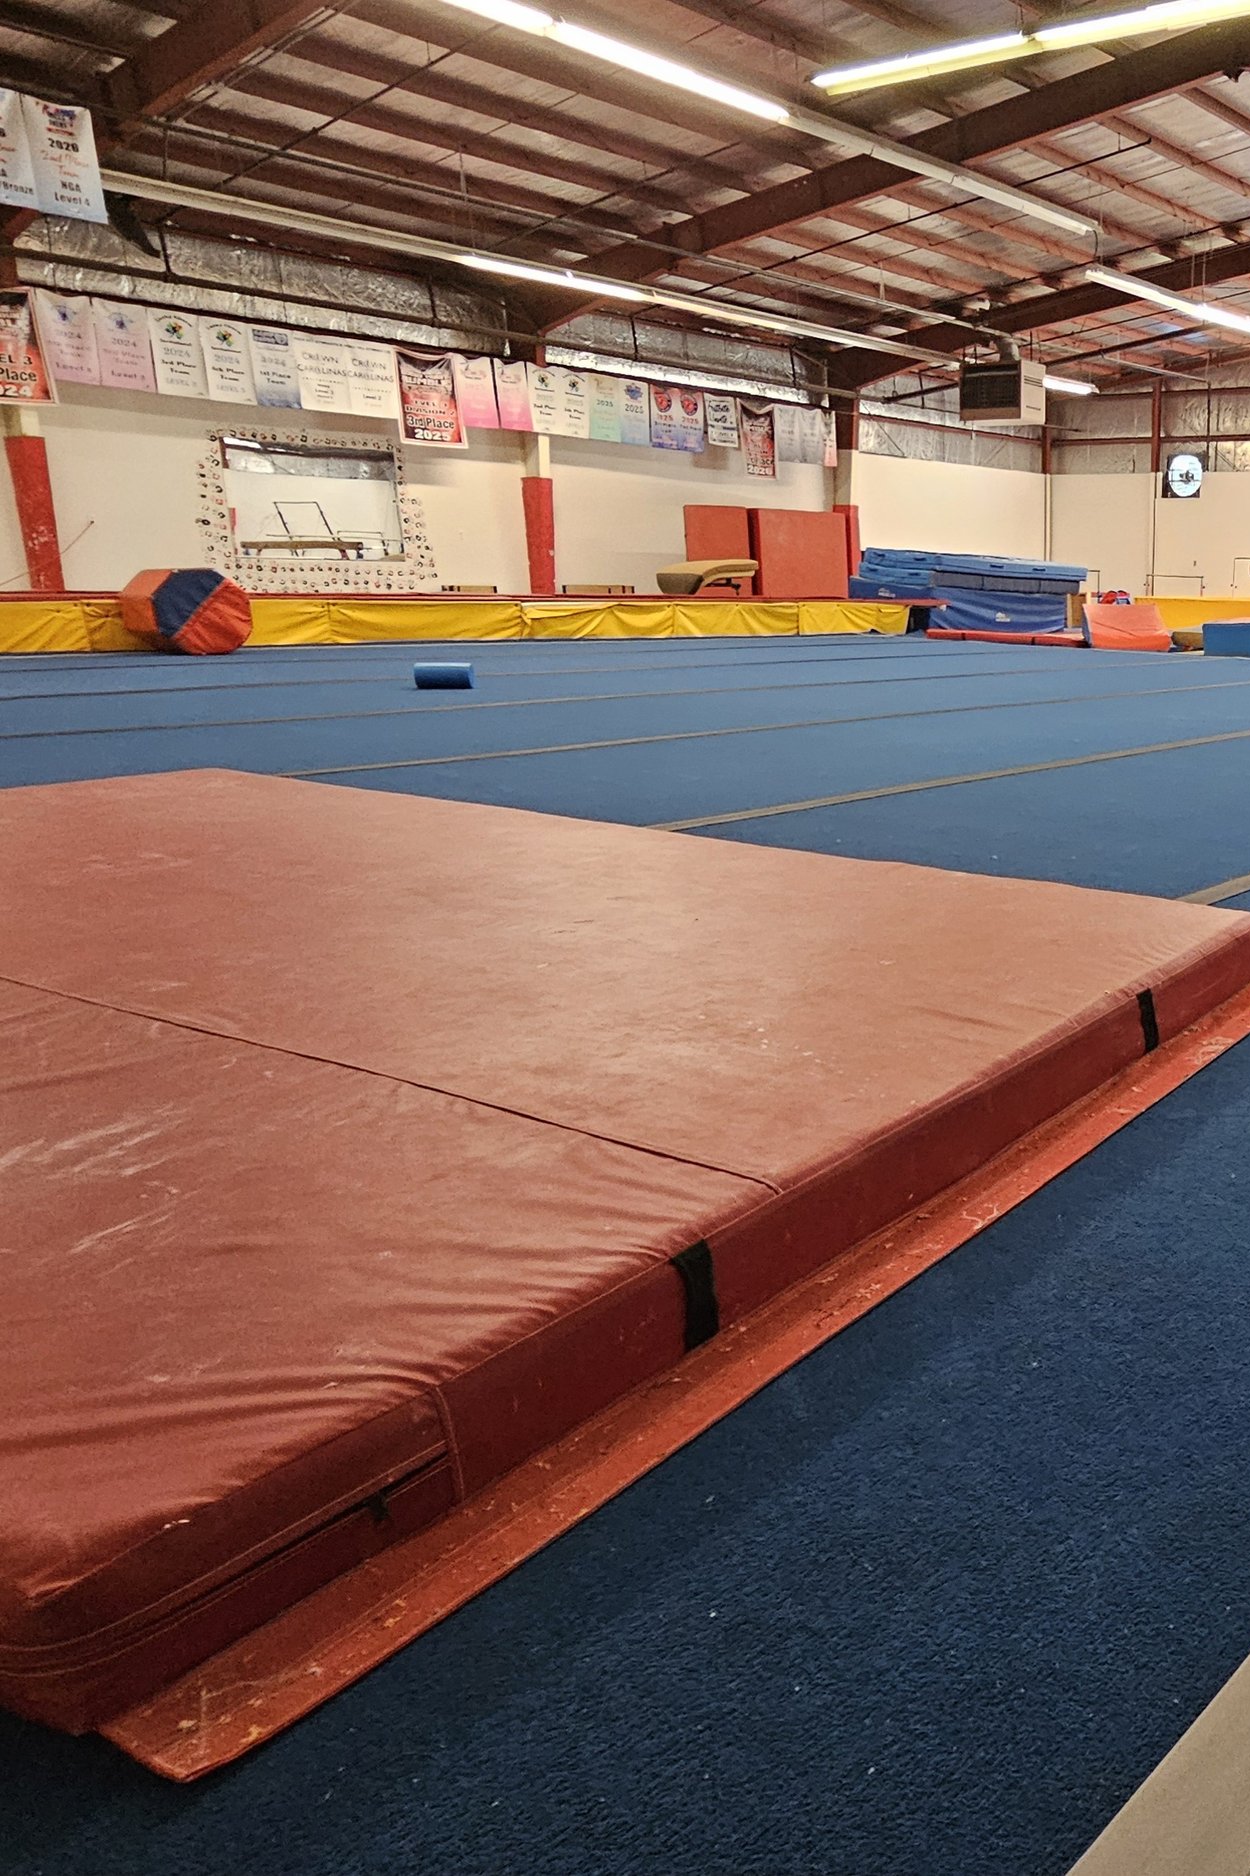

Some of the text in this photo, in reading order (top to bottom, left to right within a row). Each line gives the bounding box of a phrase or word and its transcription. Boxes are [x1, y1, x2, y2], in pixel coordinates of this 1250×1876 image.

[54, 191, 82, 205] Level
[23, 354, 33, 366] 3
[296, 363, 347, 378] CAROLINAS
[348, 370, 394, 383] CAROLINAS
[624, 403, 644, 414] 2025
[407, 414, 456, 430] 3rd Place
[414, 427, 452, 442] 2025
